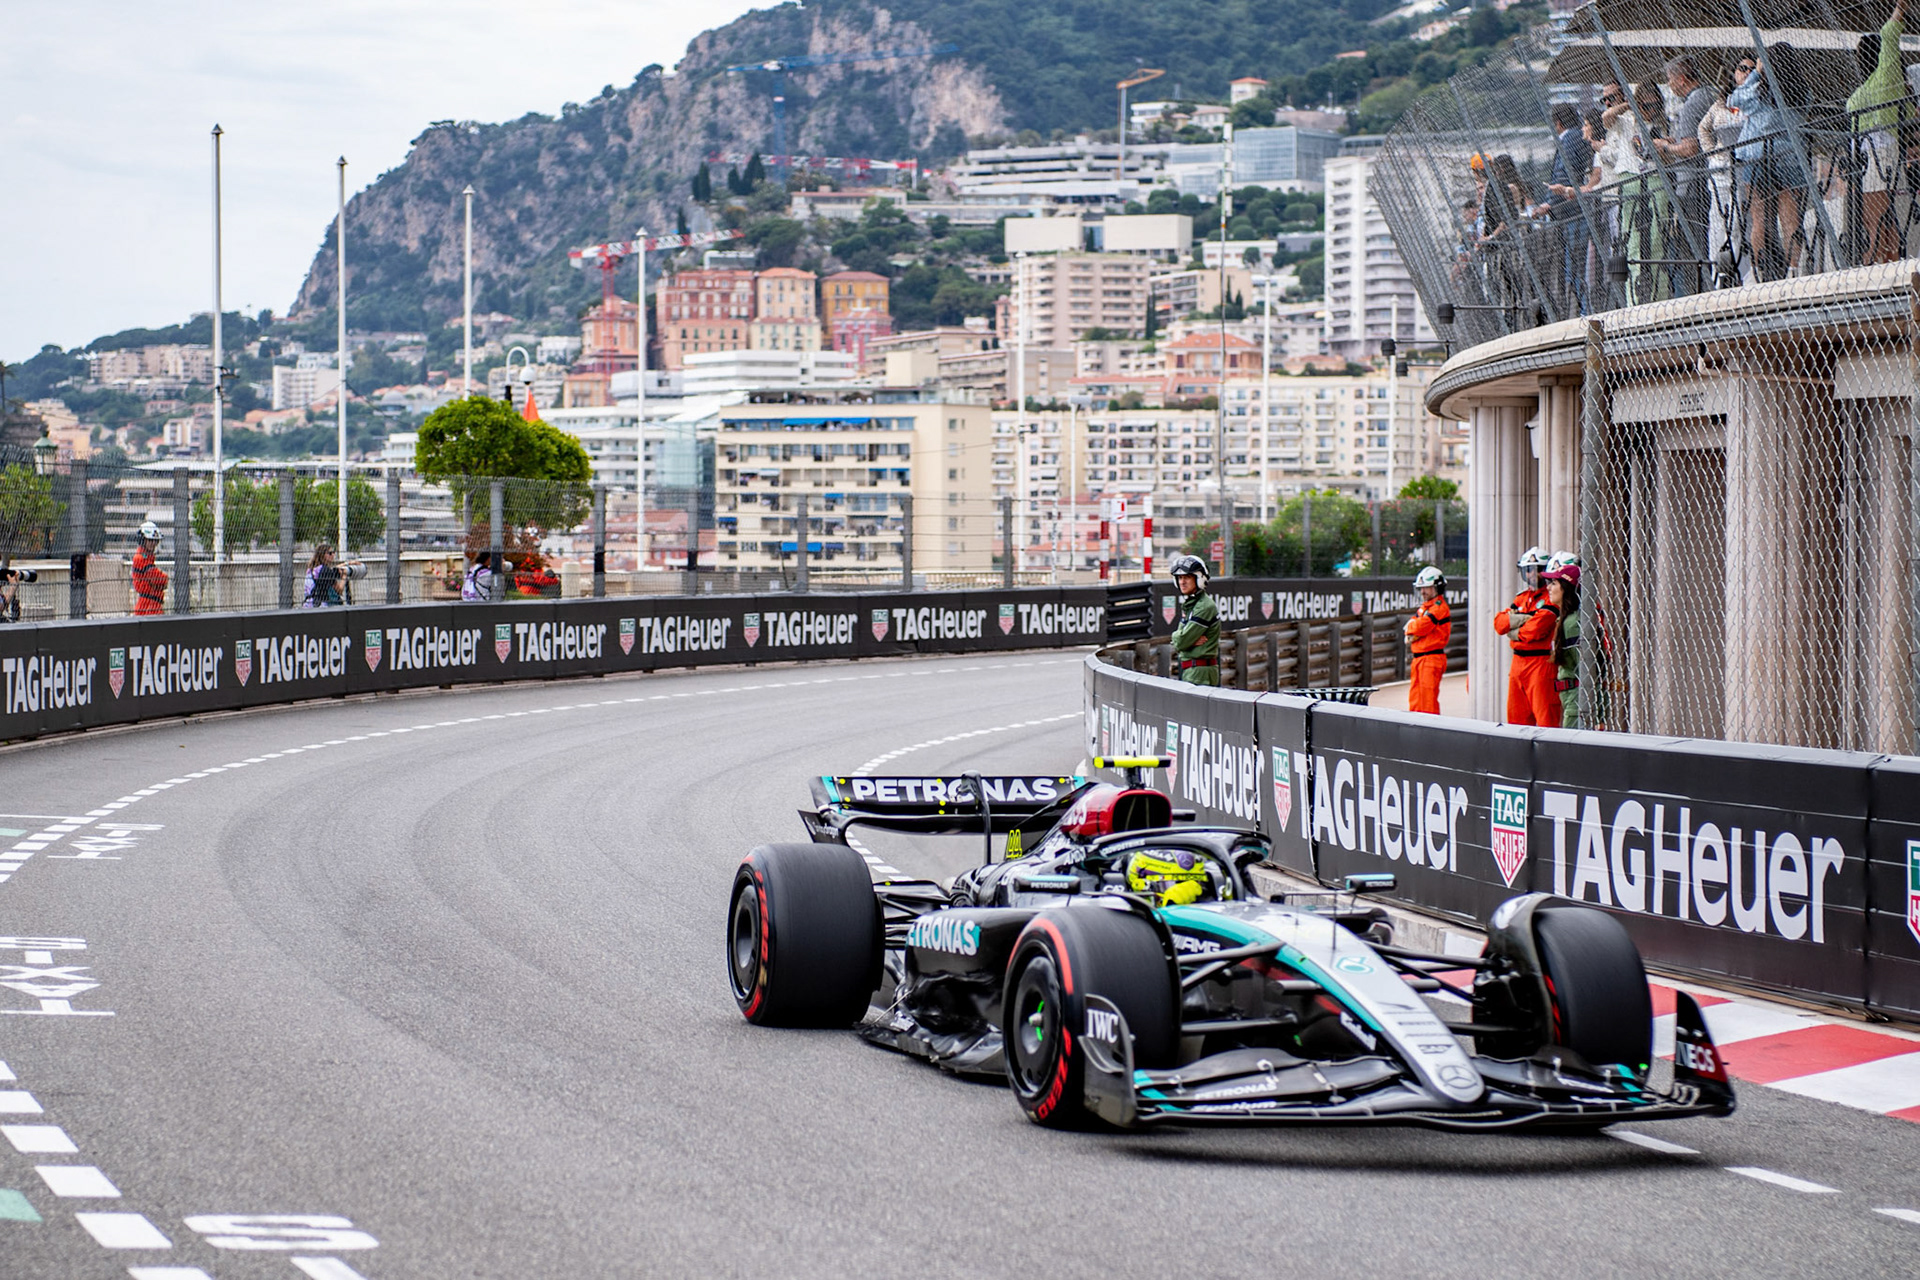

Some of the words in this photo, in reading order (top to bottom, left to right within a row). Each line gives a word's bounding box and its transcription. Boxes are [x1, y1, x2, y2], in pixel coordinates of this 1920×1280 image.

[111, 652, 124, 666] TAG
[237, 643, 250, 658] TAG
[1494, 792, 1524, 824] TAG
[1493, 830, 1524, 878] HEUER
[1543, 790, 1845, 944] TAGHeuer
[1030, 881, 1069, 889] PETRONAS
[1087, 1008, 1119, 1044] IWC
[1676, 1041, 1716, 1073] NEOS
